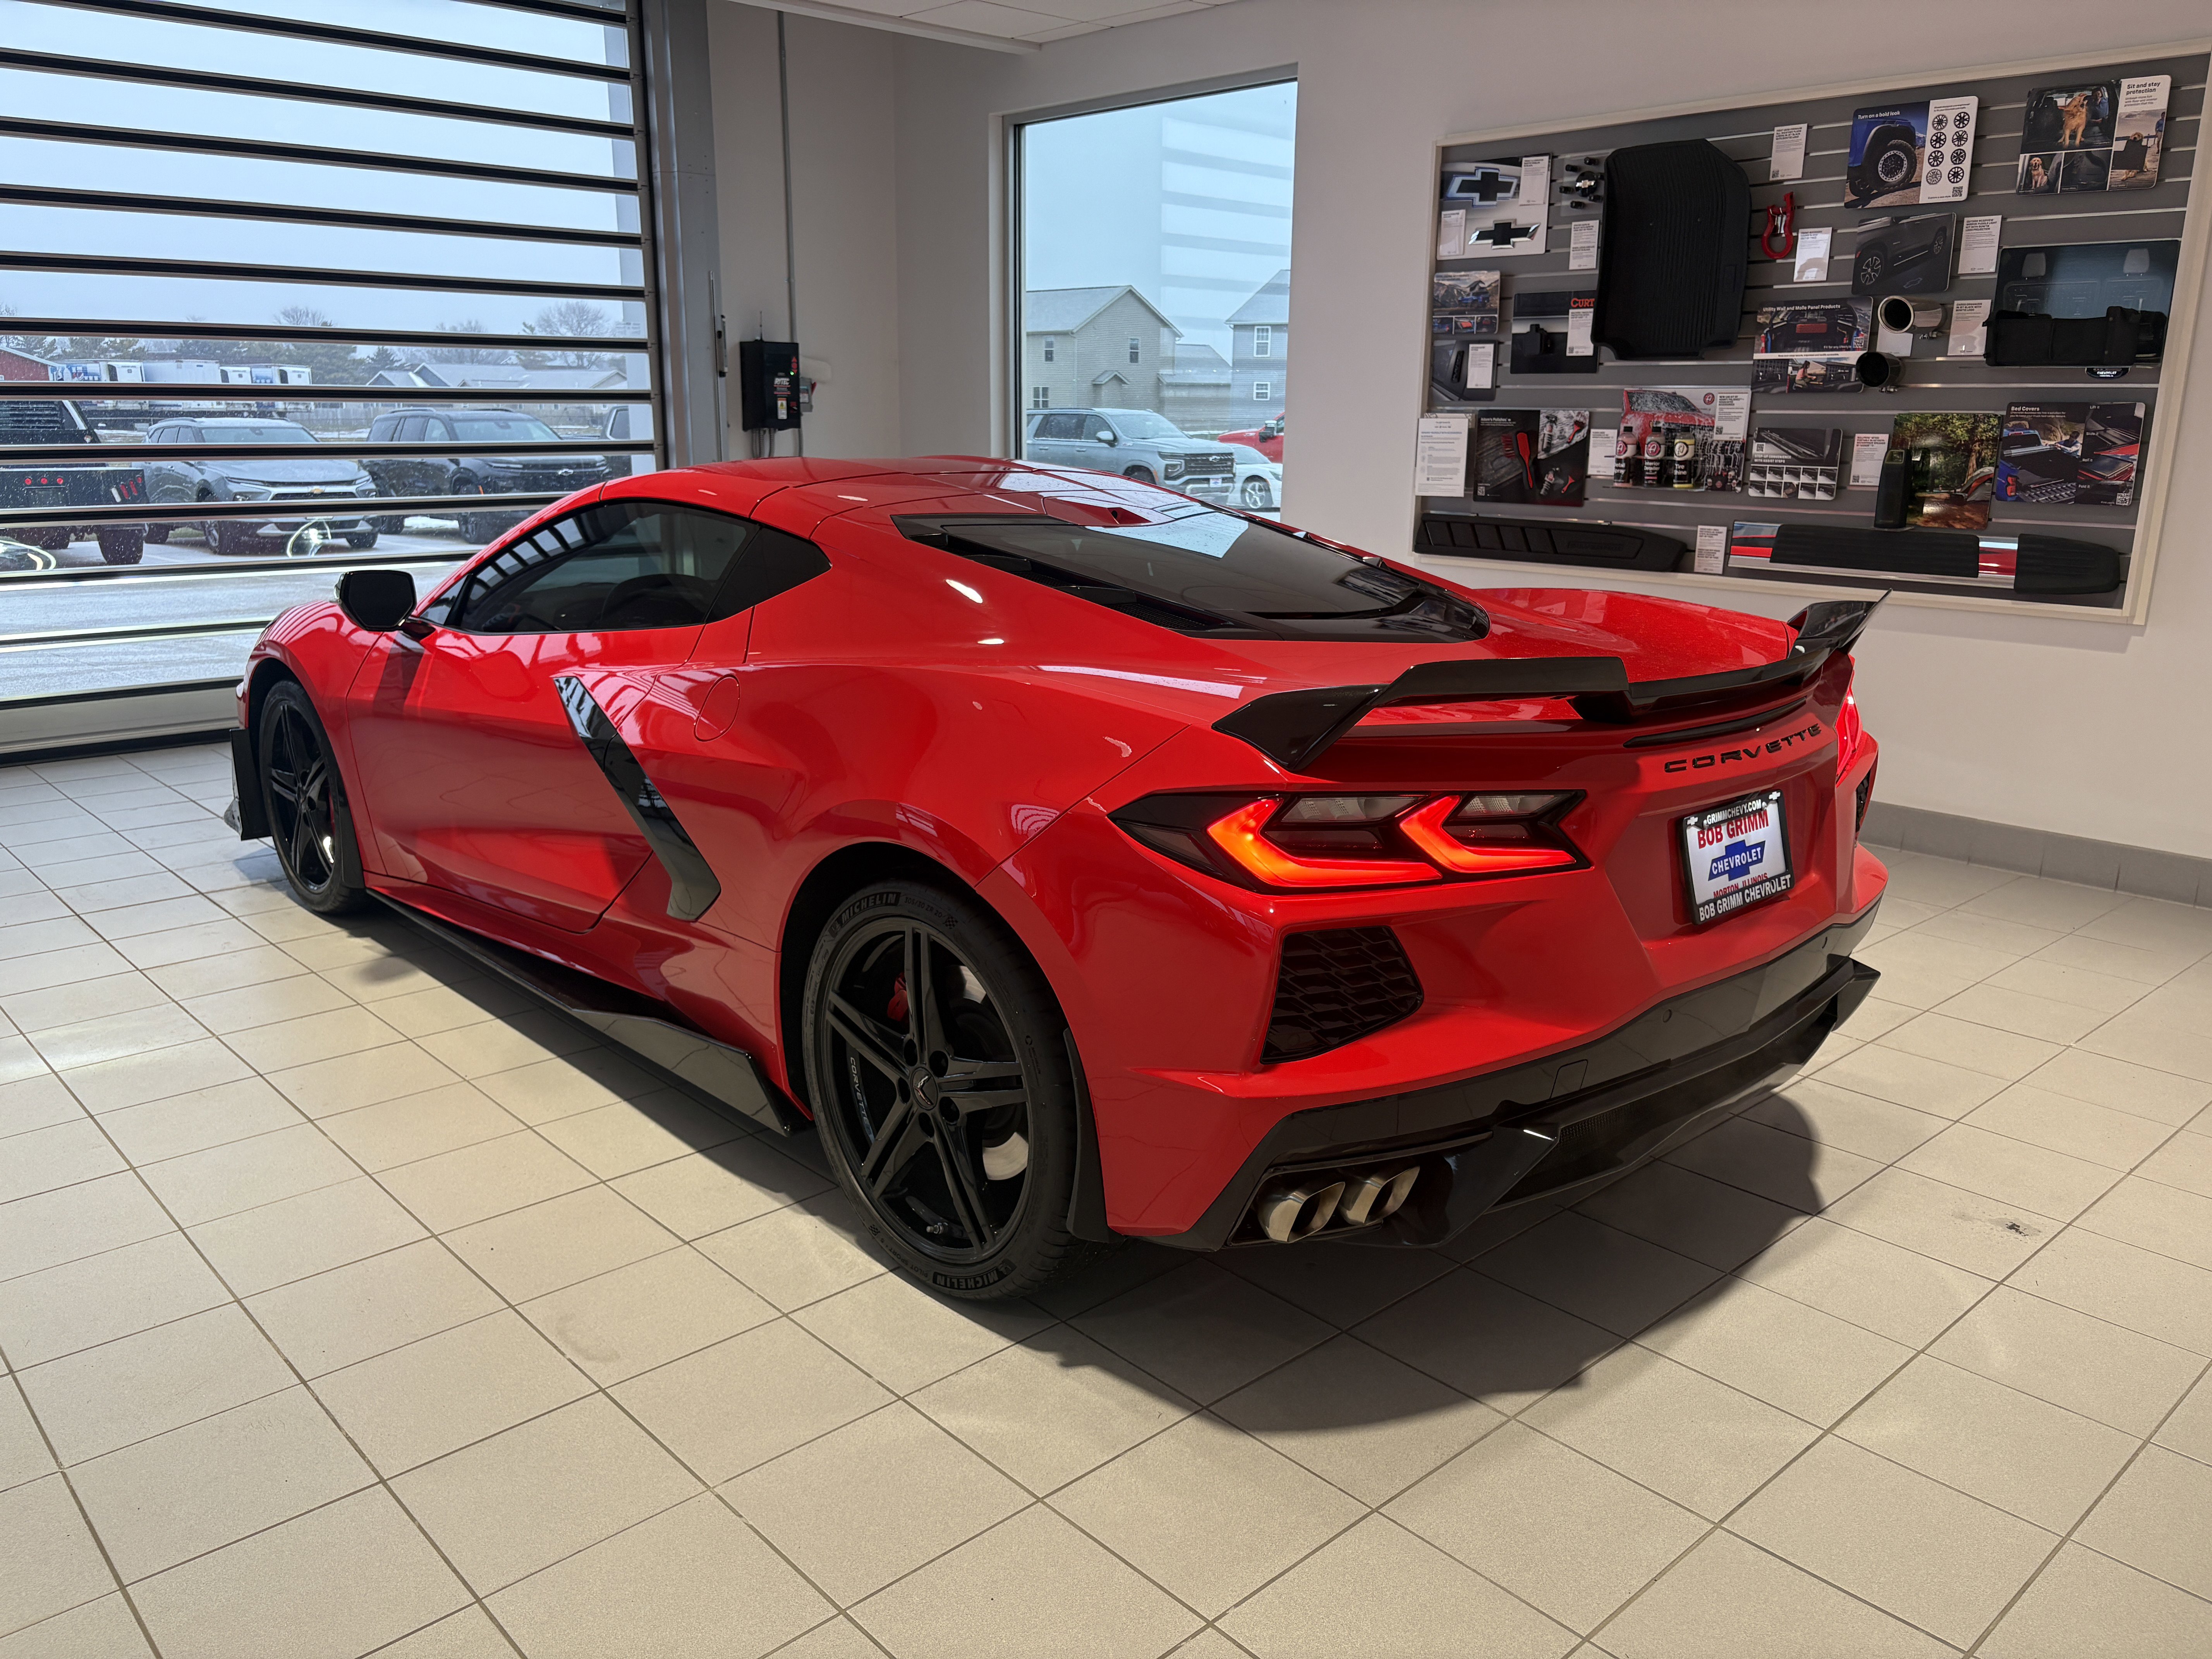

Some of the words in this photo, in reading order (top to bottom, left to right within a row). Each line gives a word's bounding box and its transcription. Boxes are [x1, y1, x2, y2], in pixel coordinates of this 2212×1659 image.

[1571, 297, 1595, 308] CURT
[1664, 723, 1821, 773] CORVETTE
[1707, 799, 1761, 825] GRIMMCHEVY.COM
[1697, 825, 1723, 849] BOB
[1726, 809, 1769, 839] GRIMM
[1712, 847, 1761, 874] CHEVROLET
[1742, 872, 1768, 887] ILLINOIS
[842, 893, 897, 923] MICHELIN
[904, 896, 925, 909] 305/30
[926, 905, 934, 913] ZR
[934, 910, 943, 918] 20
[1699, 903, 1716, 921] BOB
[1717, 892, 1743, 914] GRIMM
[1745, 874, 1791, 903] CHEVROLET
[850, 1057, 870, 1125] CORVETTE
[889, 1248, 908, 1265] SPORT
[910, 1264, 928, 1278] PILOT
[936, 1269, 998, 1289] MICHELIN
